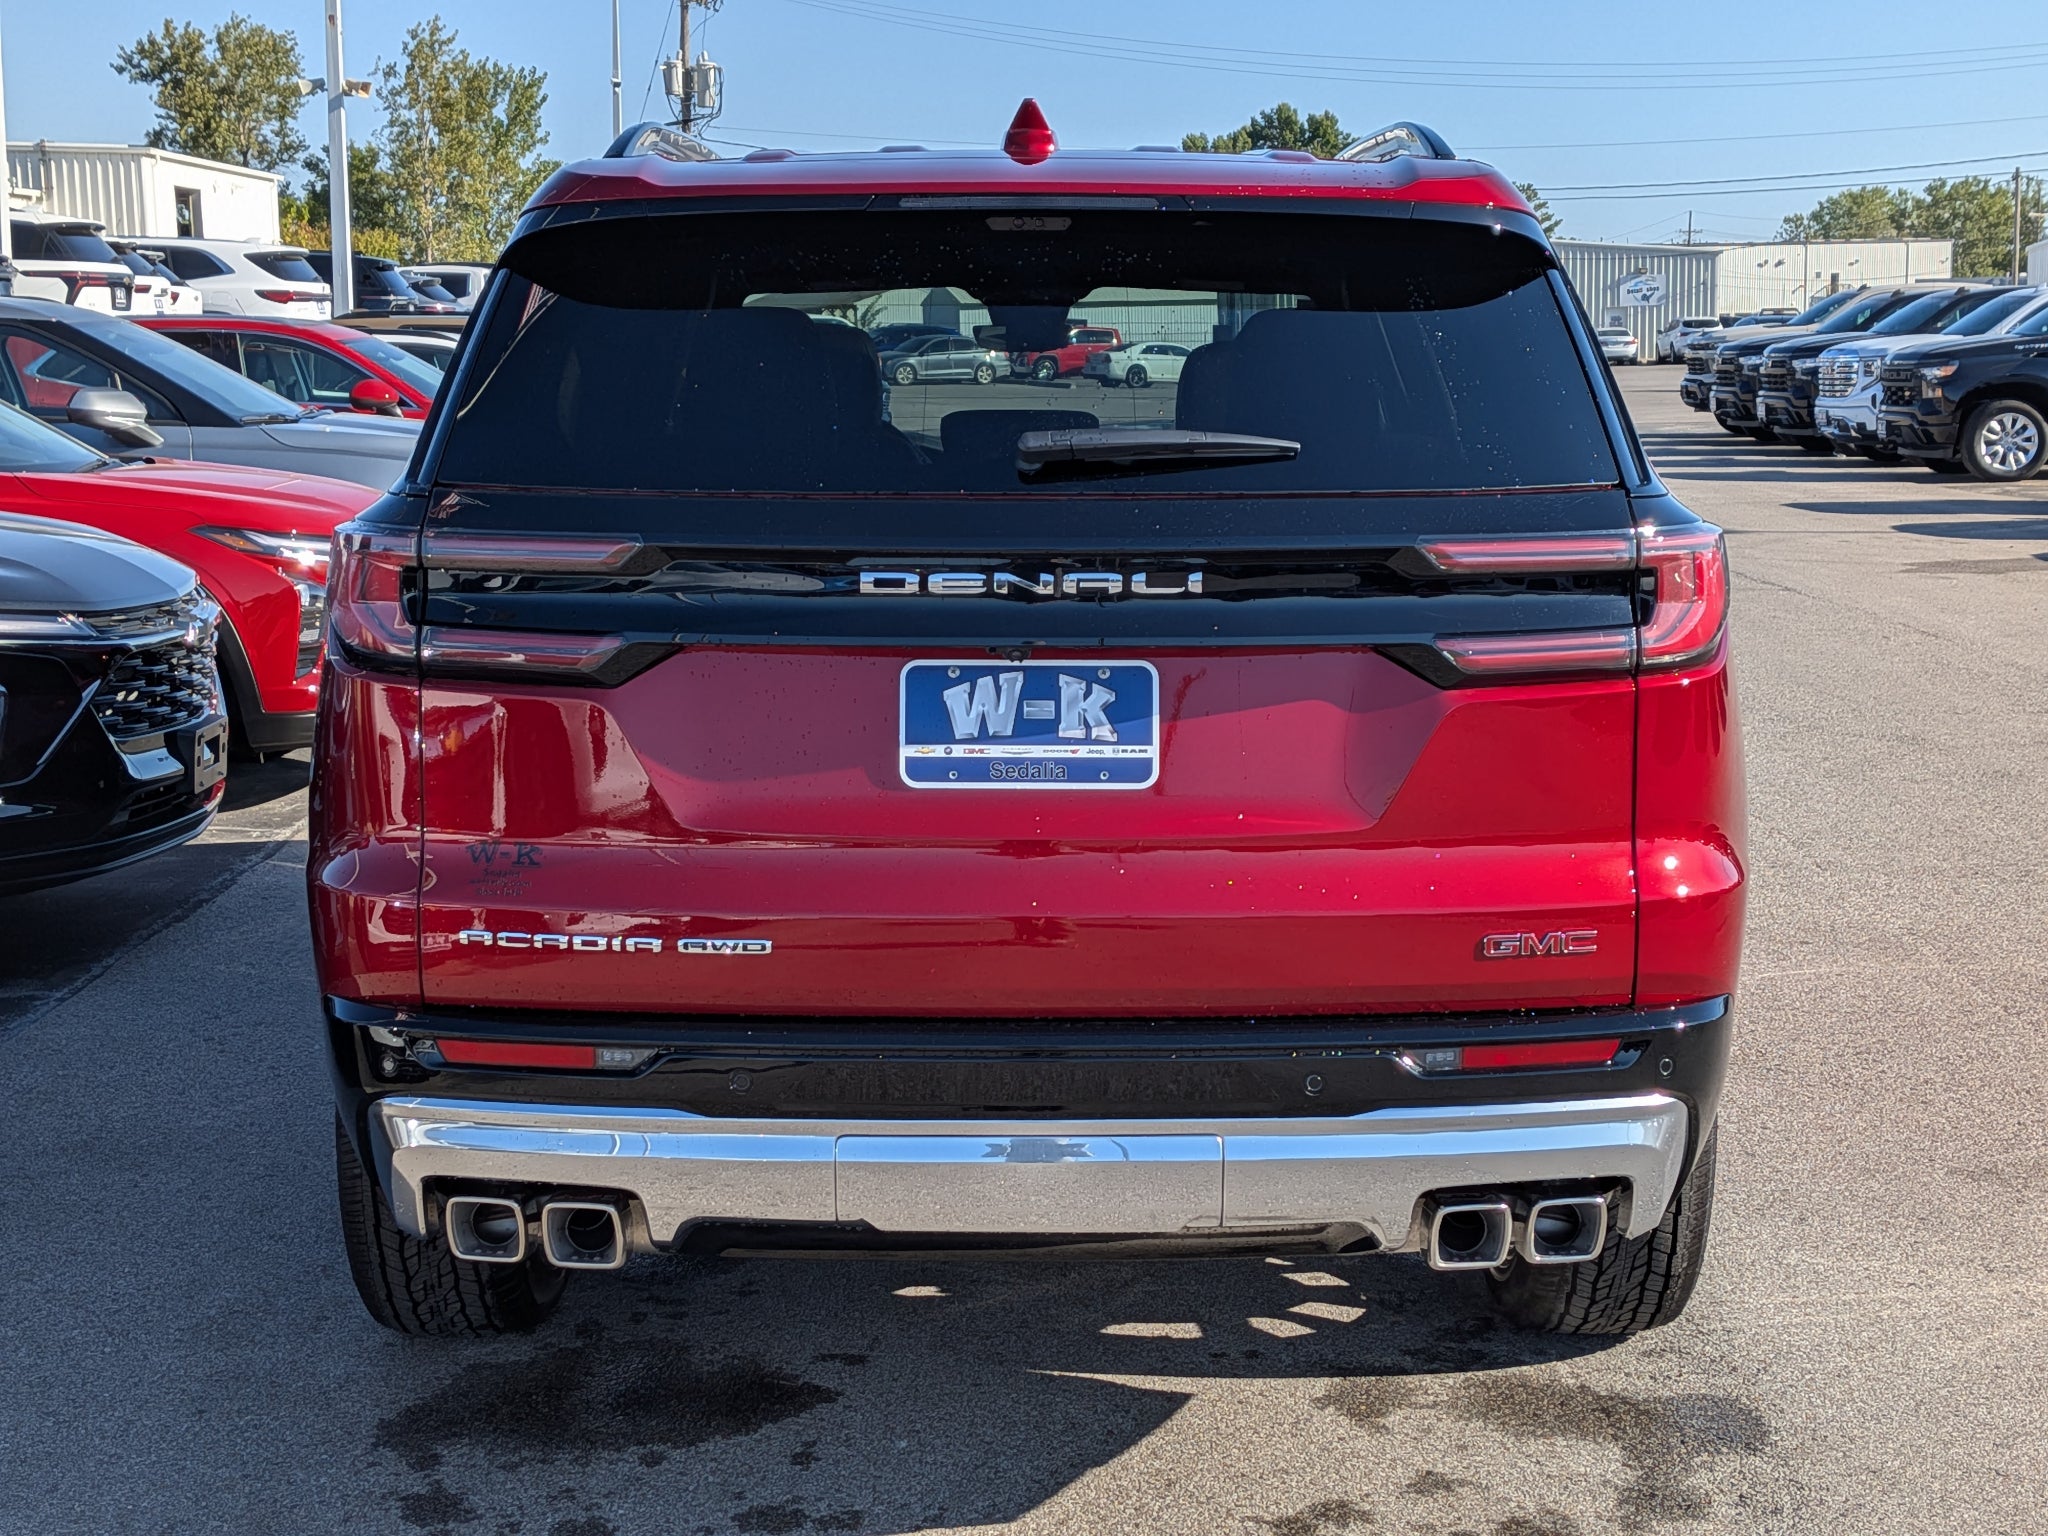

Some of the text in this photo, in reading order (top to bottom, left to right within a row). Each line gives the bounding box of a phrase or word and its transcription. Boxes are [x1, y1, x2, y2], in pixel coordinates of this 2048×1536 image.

[859, 571, 1203, 594] DENALI
[942, 670, 1118, 742] W-K
[963, 747, 991, 755] GMC
[990, 761, 1067, 779] Sedalia
[465, 841, 543, 868] W-K
[458, 929, 769, 954] ACADIA AWD
[1482, 929, 1599, 957] GMC
